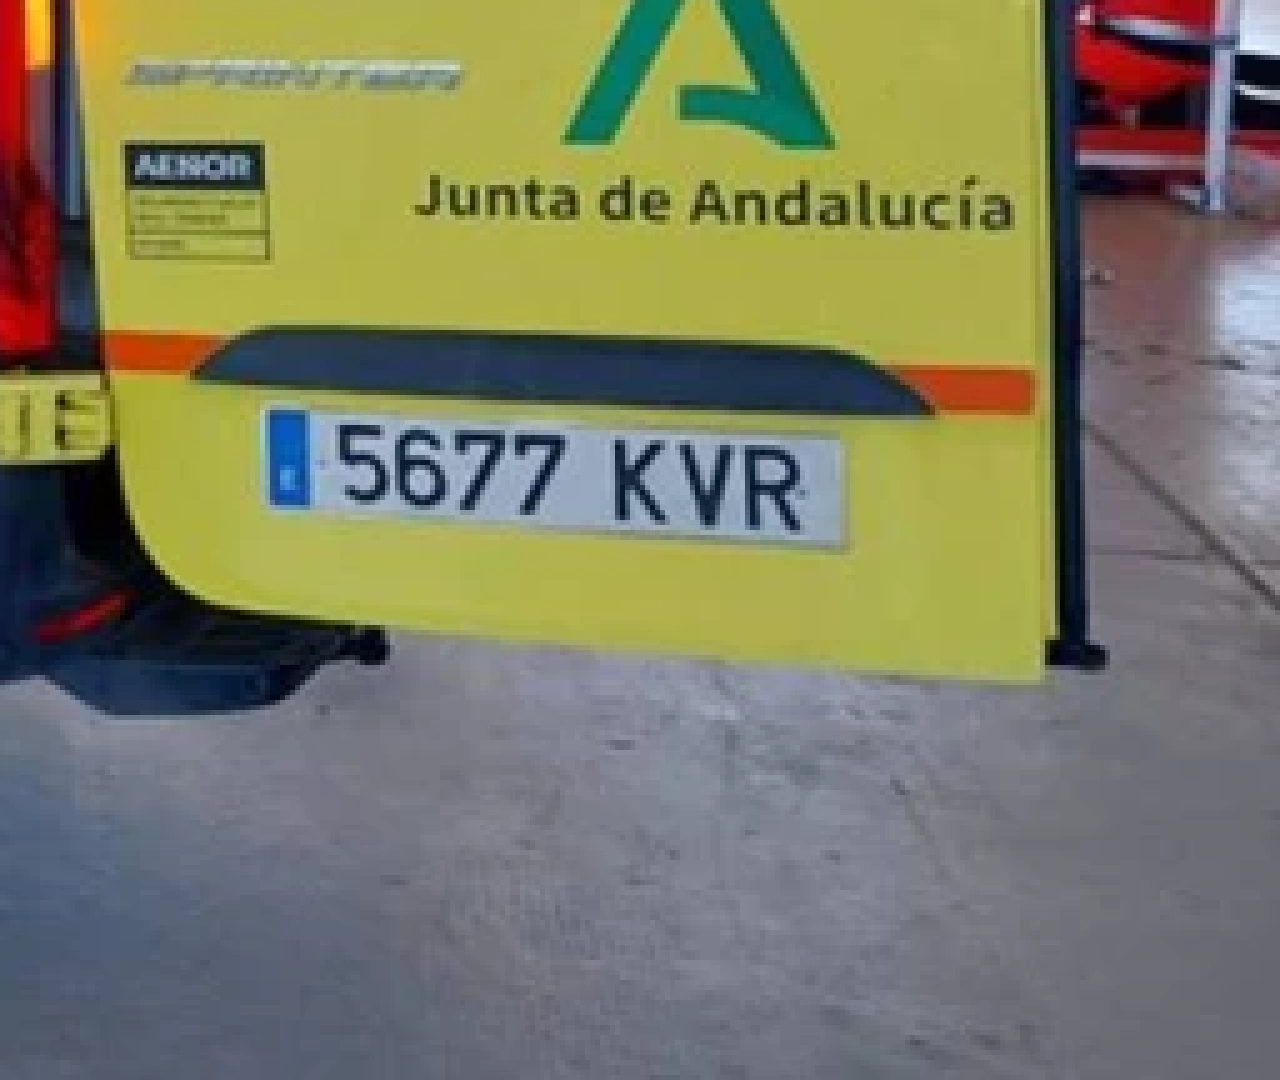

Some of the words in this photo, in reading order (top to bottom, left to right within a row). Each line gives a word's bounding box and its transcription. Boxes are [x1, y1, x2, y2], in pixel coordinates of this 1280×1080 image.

[133, 151, 253, 181] AENOR
[414, 173, 582, 221] Junta
[599, 175, 672, 224] de
[688, 174, 1018, 232] Andalucía
[336, 424, 567, 516] 5677
[612, 438, 804, 532] KVR
